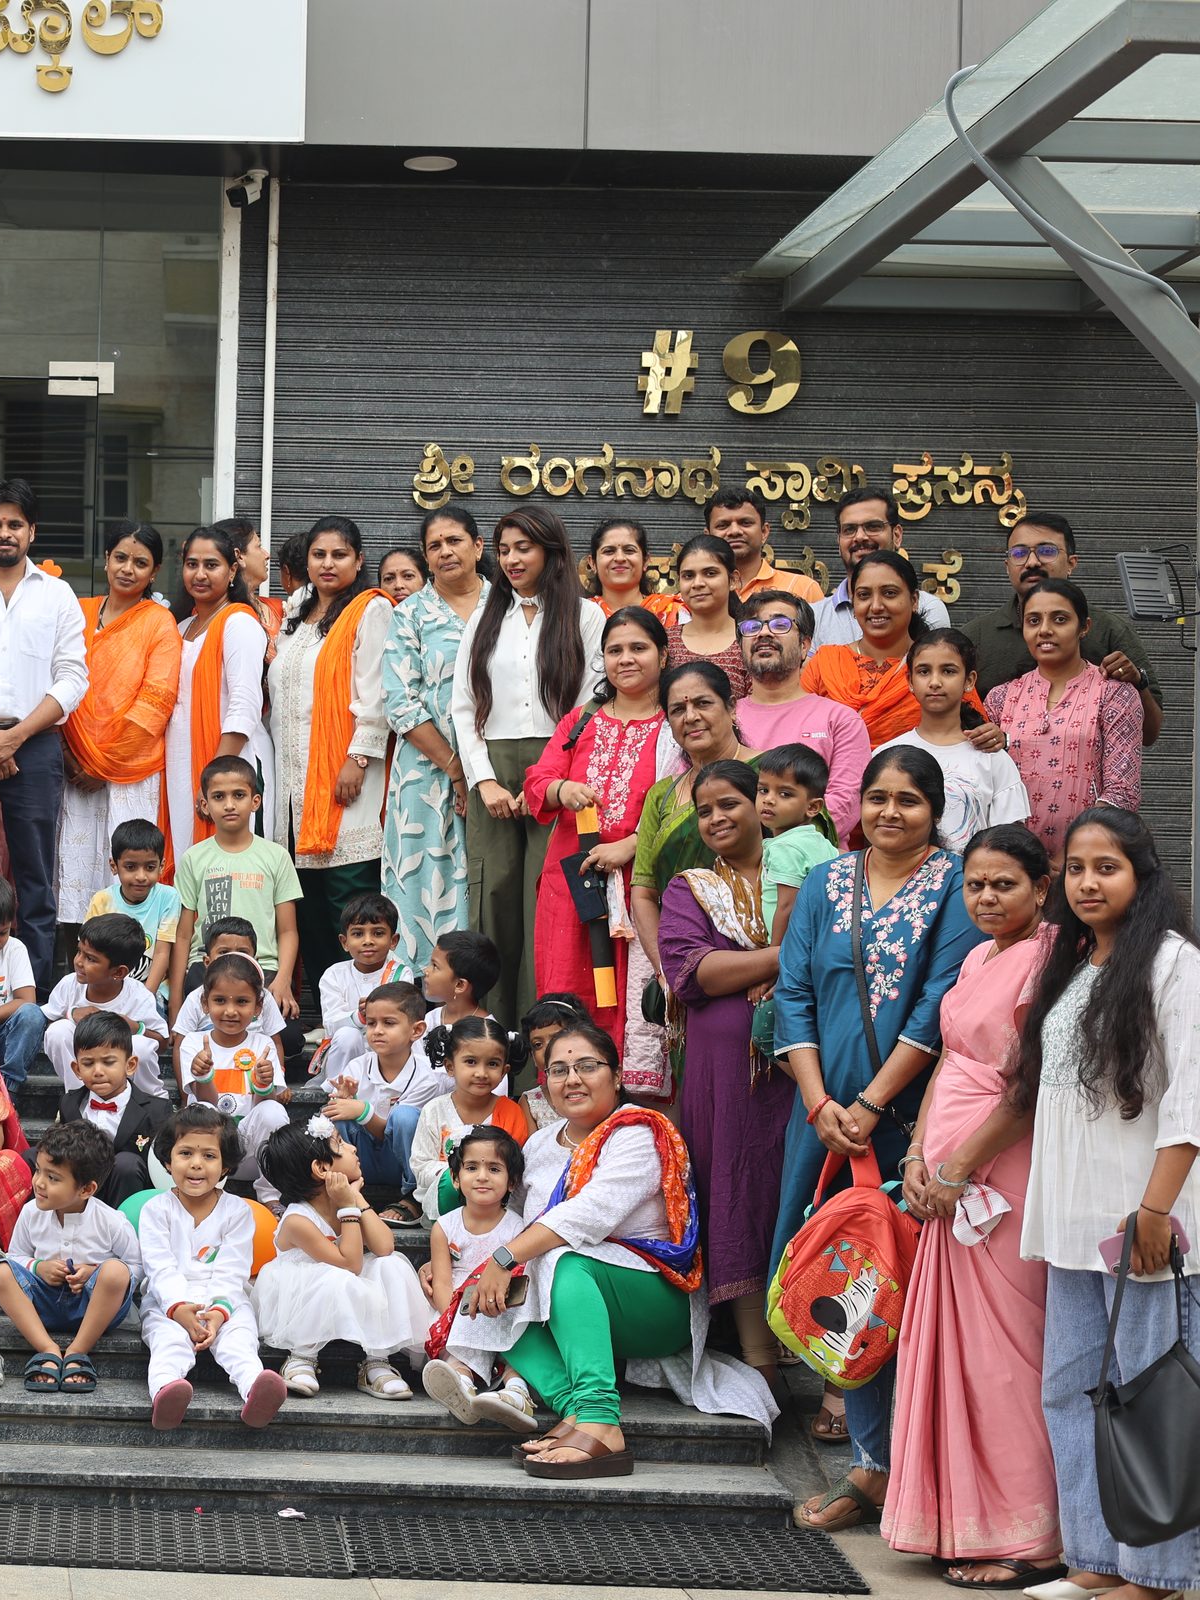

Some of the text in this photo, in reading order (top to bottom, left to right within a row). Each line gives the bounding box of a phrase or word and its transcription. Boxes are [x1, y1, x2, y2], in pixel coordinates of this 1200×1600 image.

[412, 442, 475, 510] ಶ್ರೀ
[501, 442, 721, 505] ರಂಗನಾಥ
[893, 451, 1027, 528] ಪ್ರಸನ್ನ
